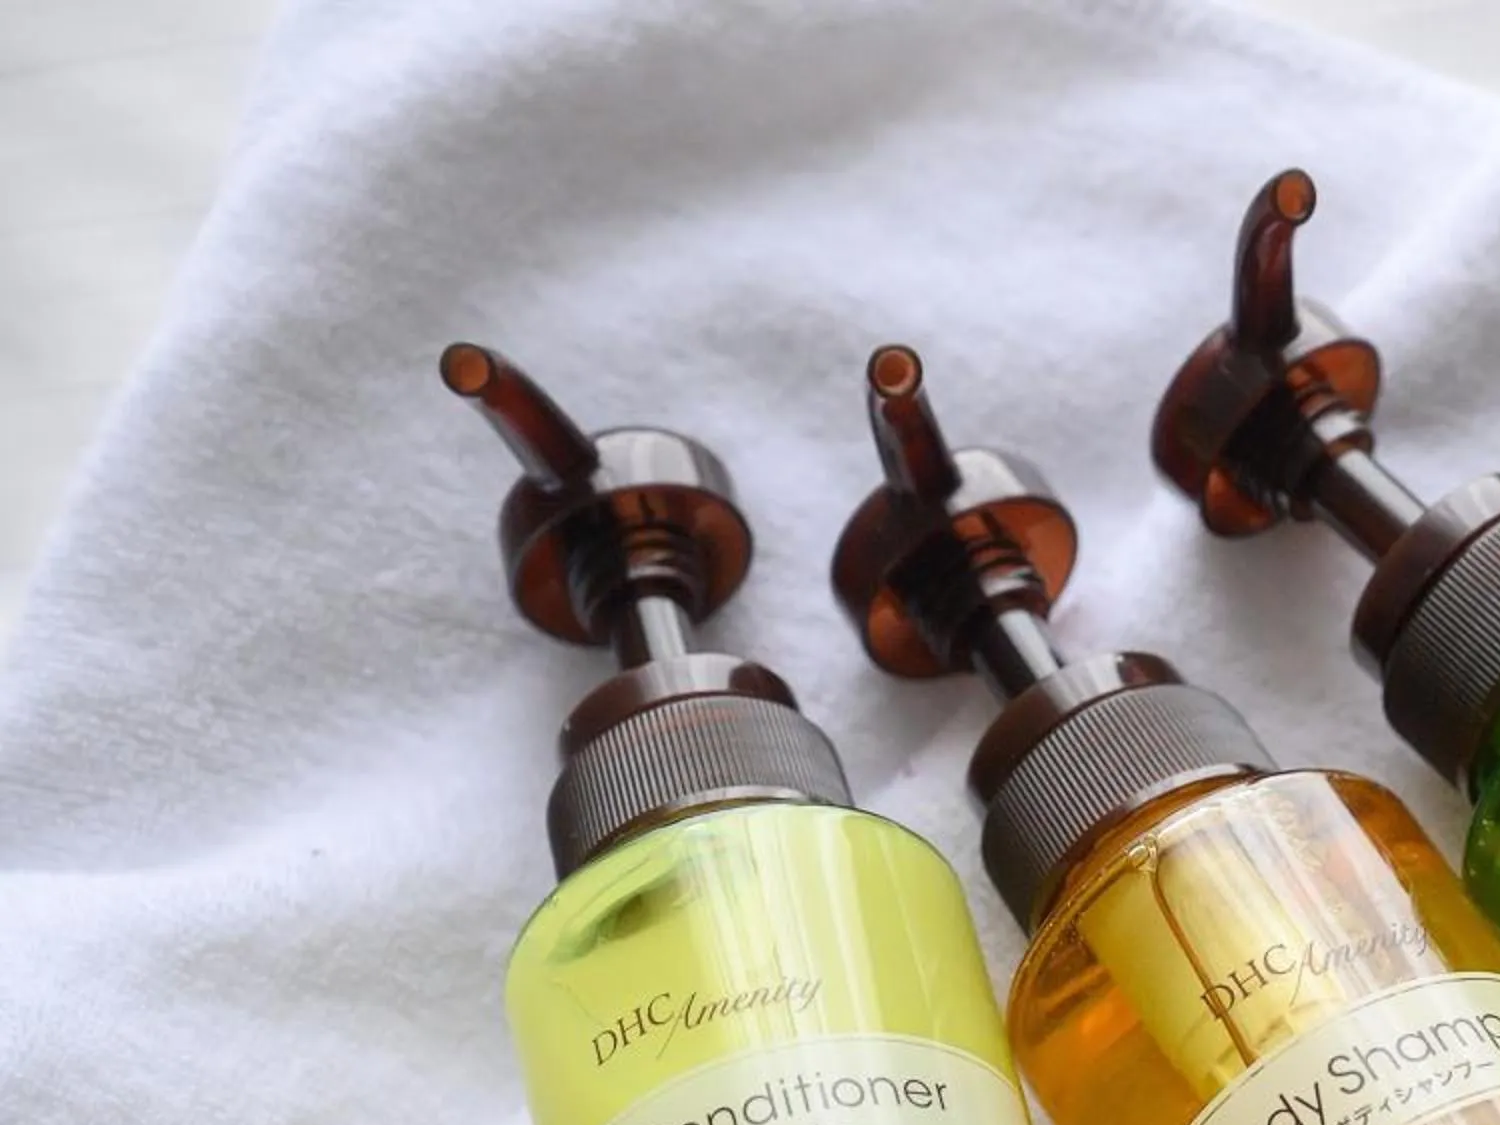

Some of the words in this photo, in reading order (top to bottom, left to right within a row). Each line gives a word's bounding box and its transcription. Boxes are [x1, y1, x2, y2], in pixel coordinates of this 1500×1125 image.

[1200, 943, 1298, 1020] DHC
[1289, 921, 1429, 1008] Amenity
[591, 992, 676, 1067] DHC
[656, 975, 823, 1060] Amenity
